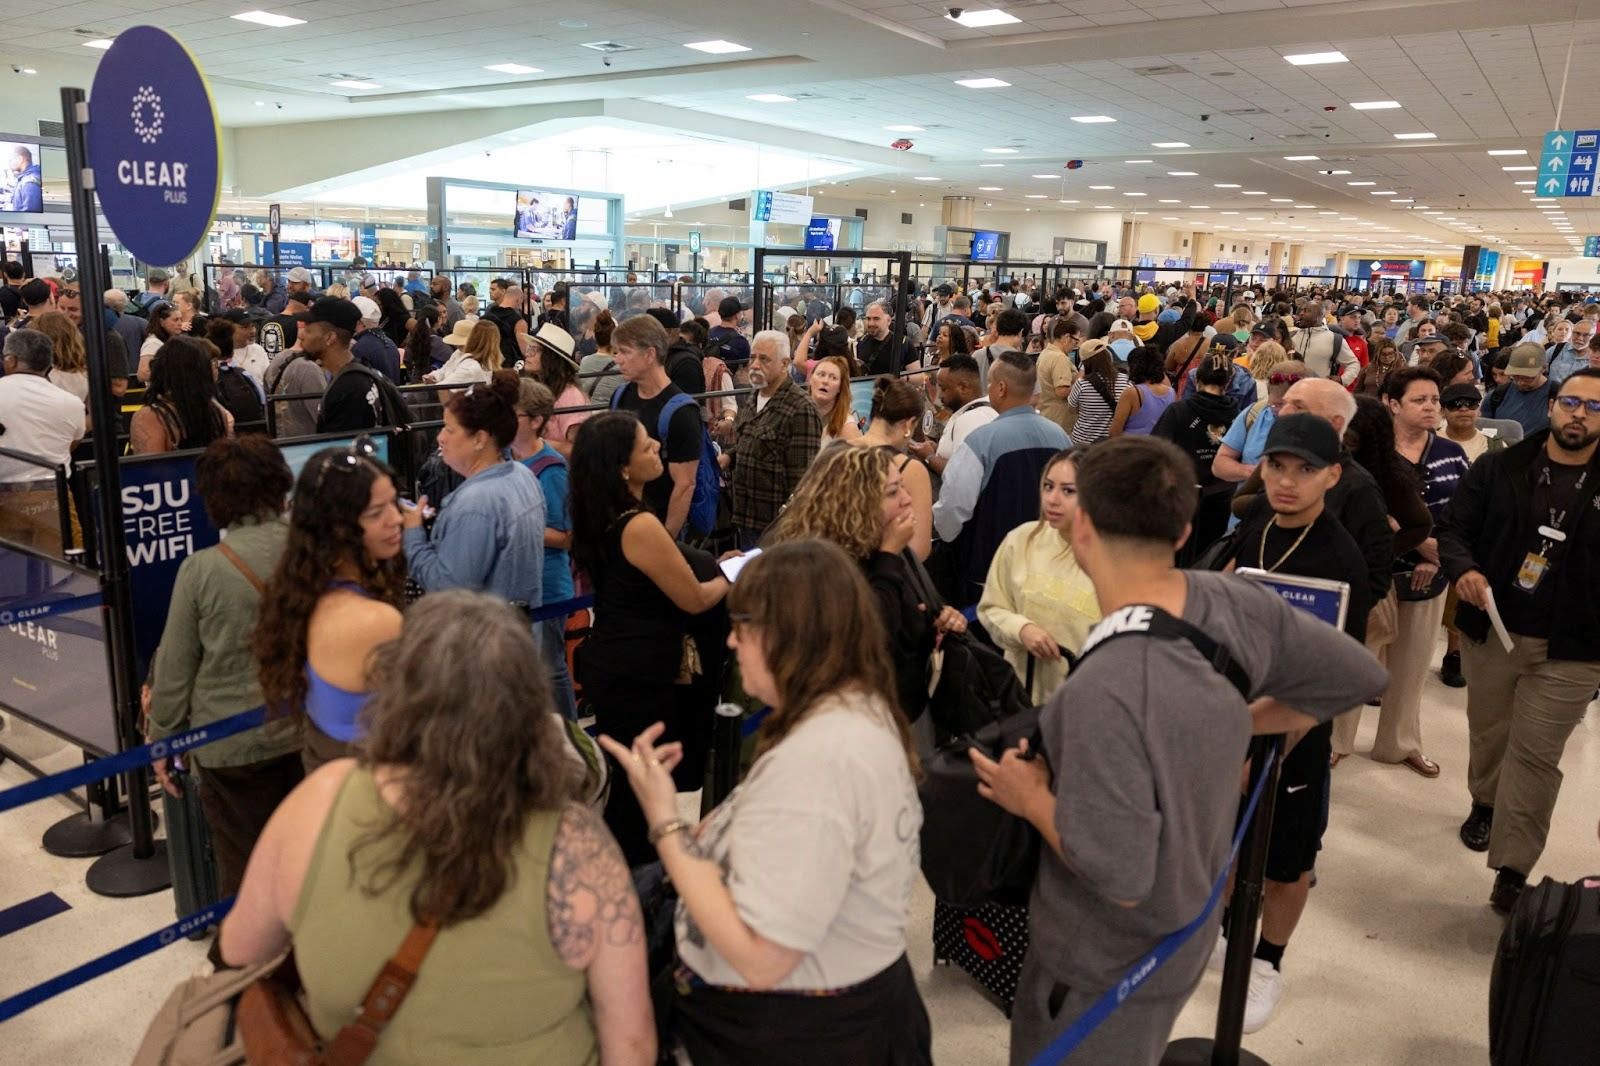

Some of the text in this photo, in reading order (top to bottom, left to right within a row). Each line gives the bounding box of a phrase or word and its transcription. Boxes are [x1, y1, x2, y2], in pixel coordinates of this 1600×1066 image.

[117, 159, 187, 187] CLEAR
[163, 189, 188, 204] PLUS
[121, 478, 190, 515] SJU
[126, 533, 194, 567] WIFI
[1281, 590, 1316, 603] CLEAR
[17, 605, 51, 618] CLEAR
[171, 730, 208, 749] CLEAR
[180, 911, 215, 933] CLEAR
